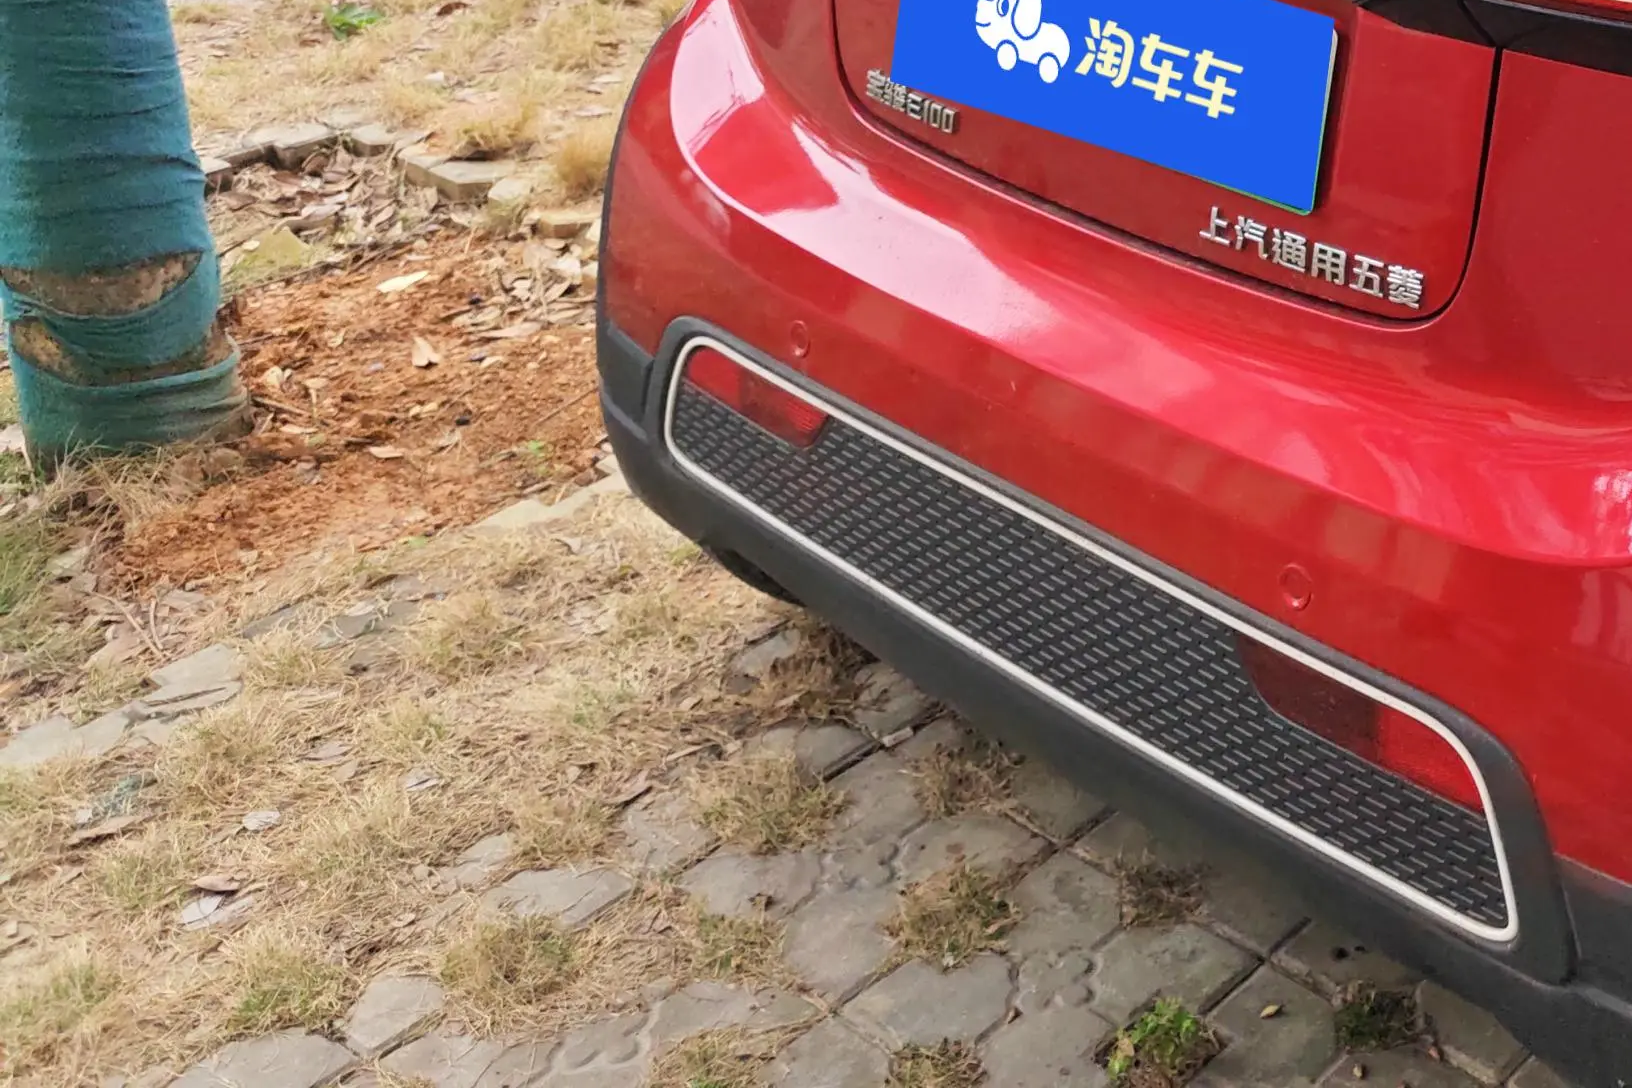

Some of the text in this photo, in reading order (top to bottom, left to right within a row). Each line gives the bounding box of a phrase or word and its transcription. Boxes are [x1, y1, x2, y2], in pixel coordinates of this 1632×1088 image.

[1198, 205, 1424, 310] 上汽通用五菱
